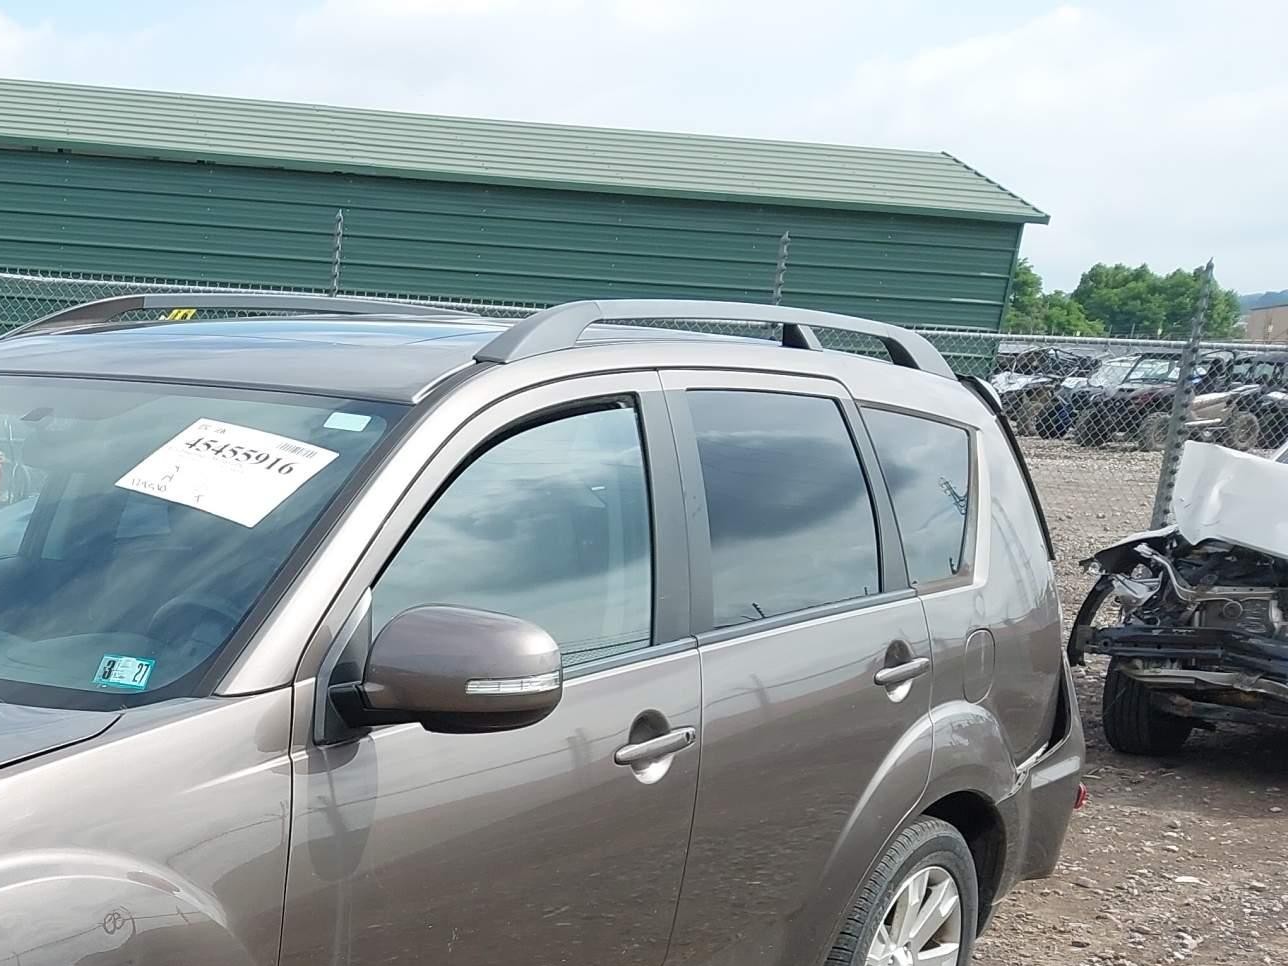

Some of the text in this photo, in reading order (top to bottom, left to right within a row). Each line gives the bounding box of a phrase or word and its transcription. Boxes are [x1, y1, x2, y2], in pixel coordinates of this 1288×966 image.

[184, 437, 298, 476] 45455916
[102, 659, 117, 680] 3
[132, 662, 150, 684] 27
